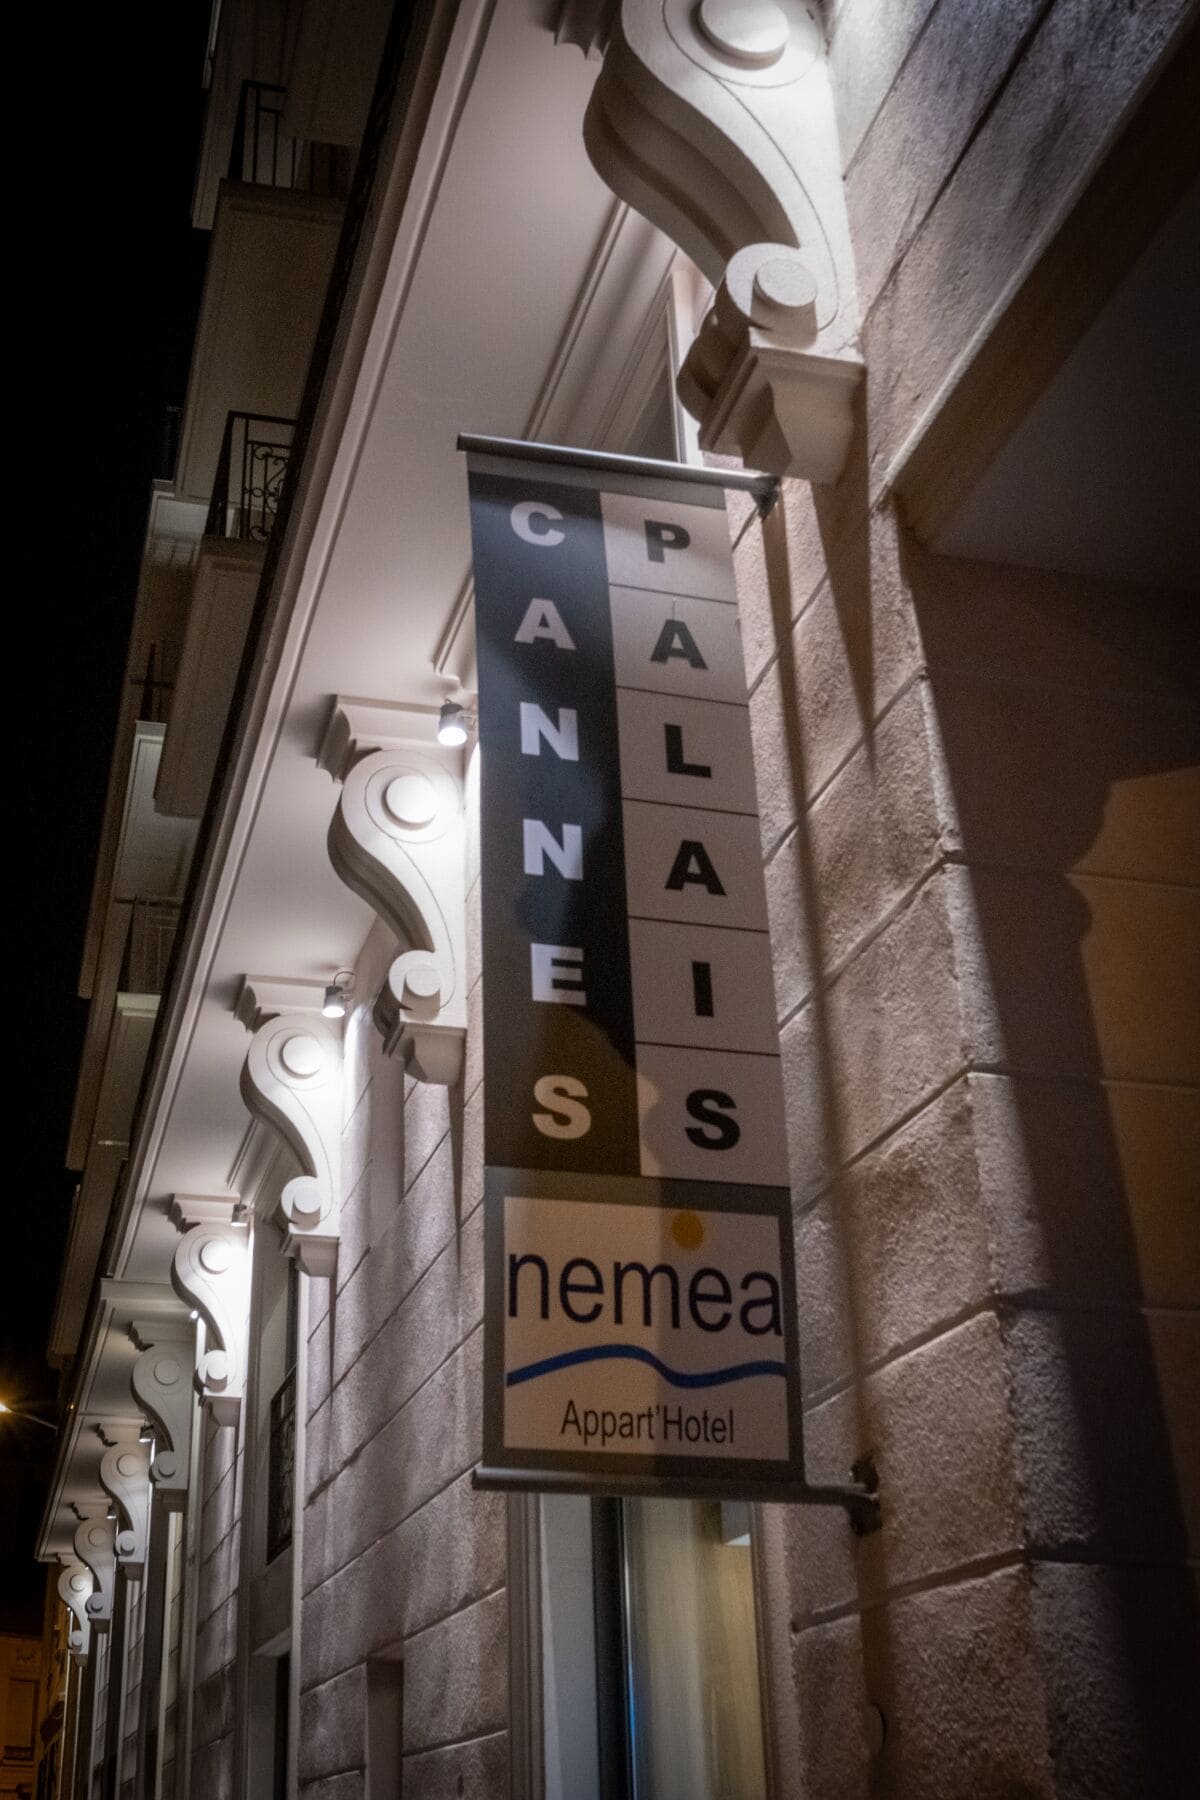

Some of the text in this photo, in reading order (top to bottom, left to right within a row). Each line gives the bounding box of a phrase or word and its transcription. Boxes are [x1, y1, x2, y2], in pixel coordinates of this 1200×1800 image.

[510, 500, 592, 1140] CANNES
[643, 519, 741, 1150] PALAIS
[508, 1253, 783, 1336] nemea
[560, 1399, 734, 1446] Appart'Hotel
